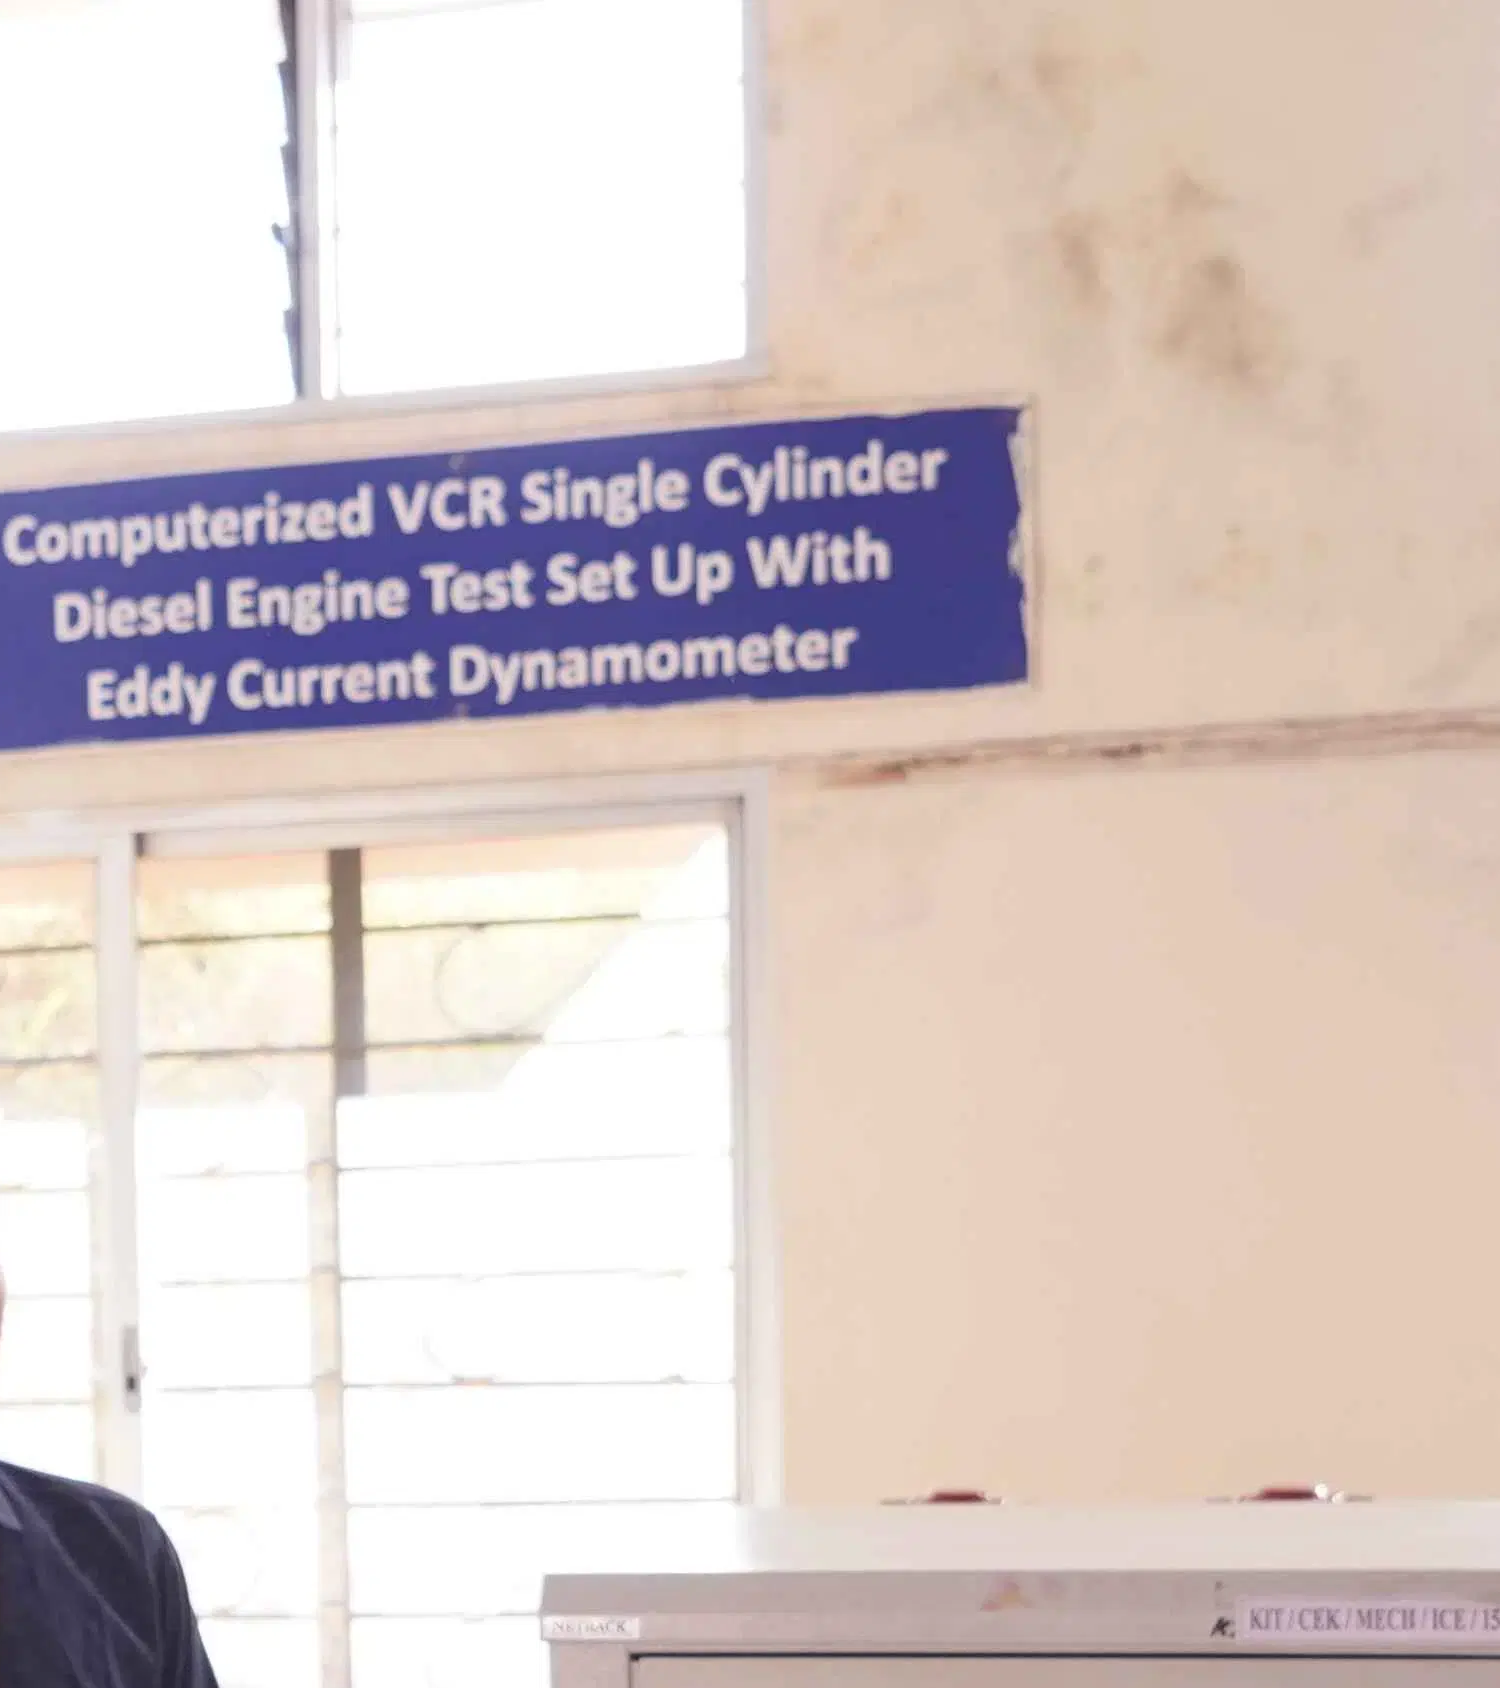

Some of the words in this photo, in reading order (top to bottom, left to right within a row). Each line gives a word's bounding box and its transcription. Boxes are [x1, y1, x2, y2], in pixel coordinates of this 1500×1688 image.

[3, 483, 373, 566] Computerized
[387, 476, 508, 534] VCR
[520, 458, 690, 528] Single
[703, 440, 948, 516] Cylinder
[53, 578, 212, 642] Diesel
[226, 569, 409, 636] Engine
[421, 561, 534, 614] Test
[546, 550, 638, 606] Set
[651, 543, 734, 604] Up
[747, 526, 891, 590] With
[87, 661, 216, 725] Eddy
[227, 651, 435, 710] Current
[449, 624, 858, 704] Dynamometer
[1250, 1608, 1283, 1631] KIT
[1300, 1608, 1342, 1631] CEK
[1432, 1608, 1466, 1631] ICE
